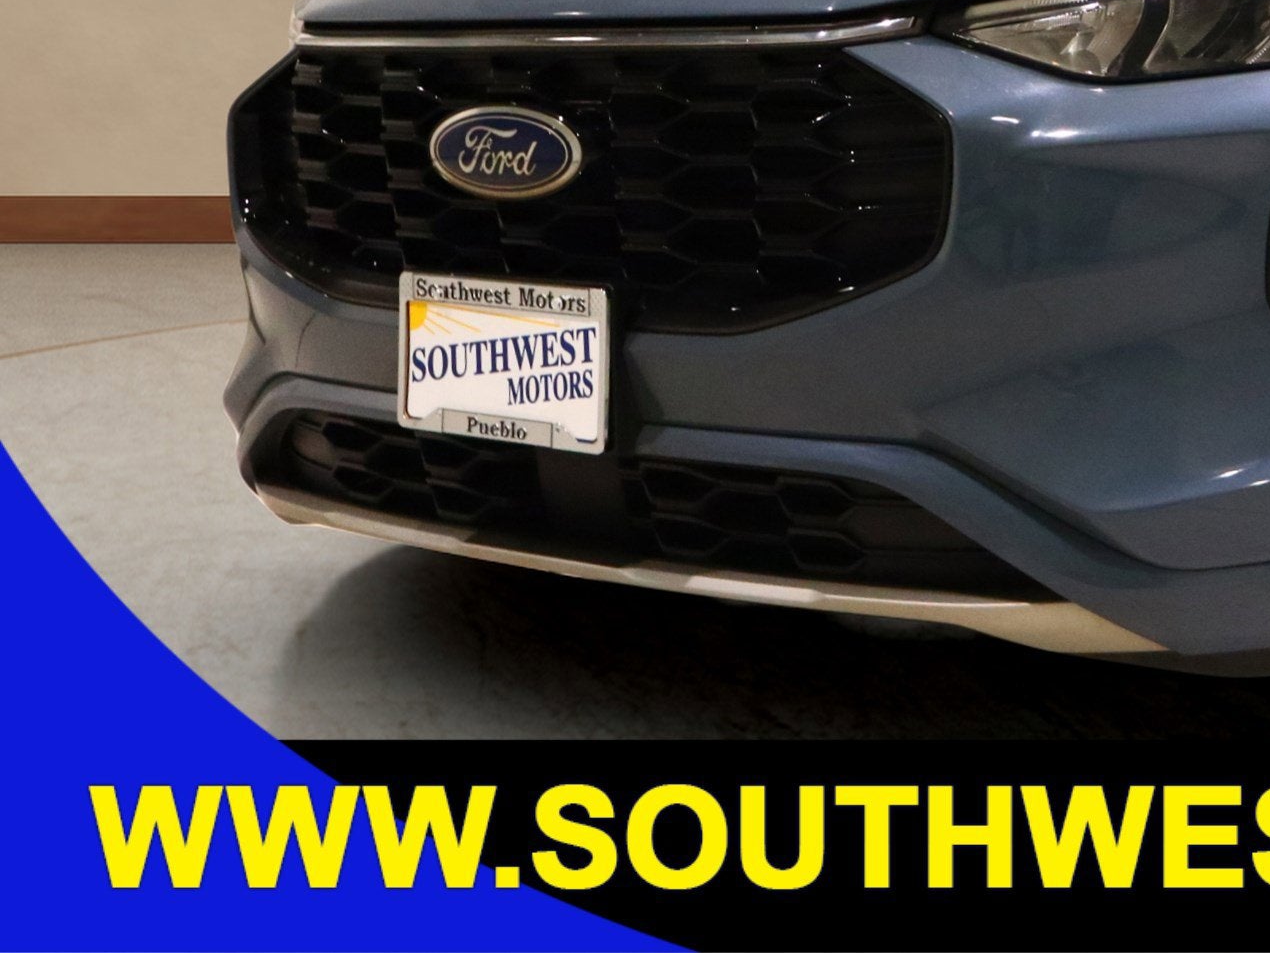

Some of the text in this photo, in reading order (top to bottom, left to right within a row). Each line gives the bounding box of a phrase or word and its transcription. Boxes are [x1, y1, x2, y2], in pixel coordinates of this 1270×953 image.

[458, 125, 538, 176] Ford
[415, 277, 511, 306] Southwest
[411, 327, 596, 383] SOUTHWEST
[507, 369, 594, 405] MOTORS
[466, 416, 527, 441] Pueblo
